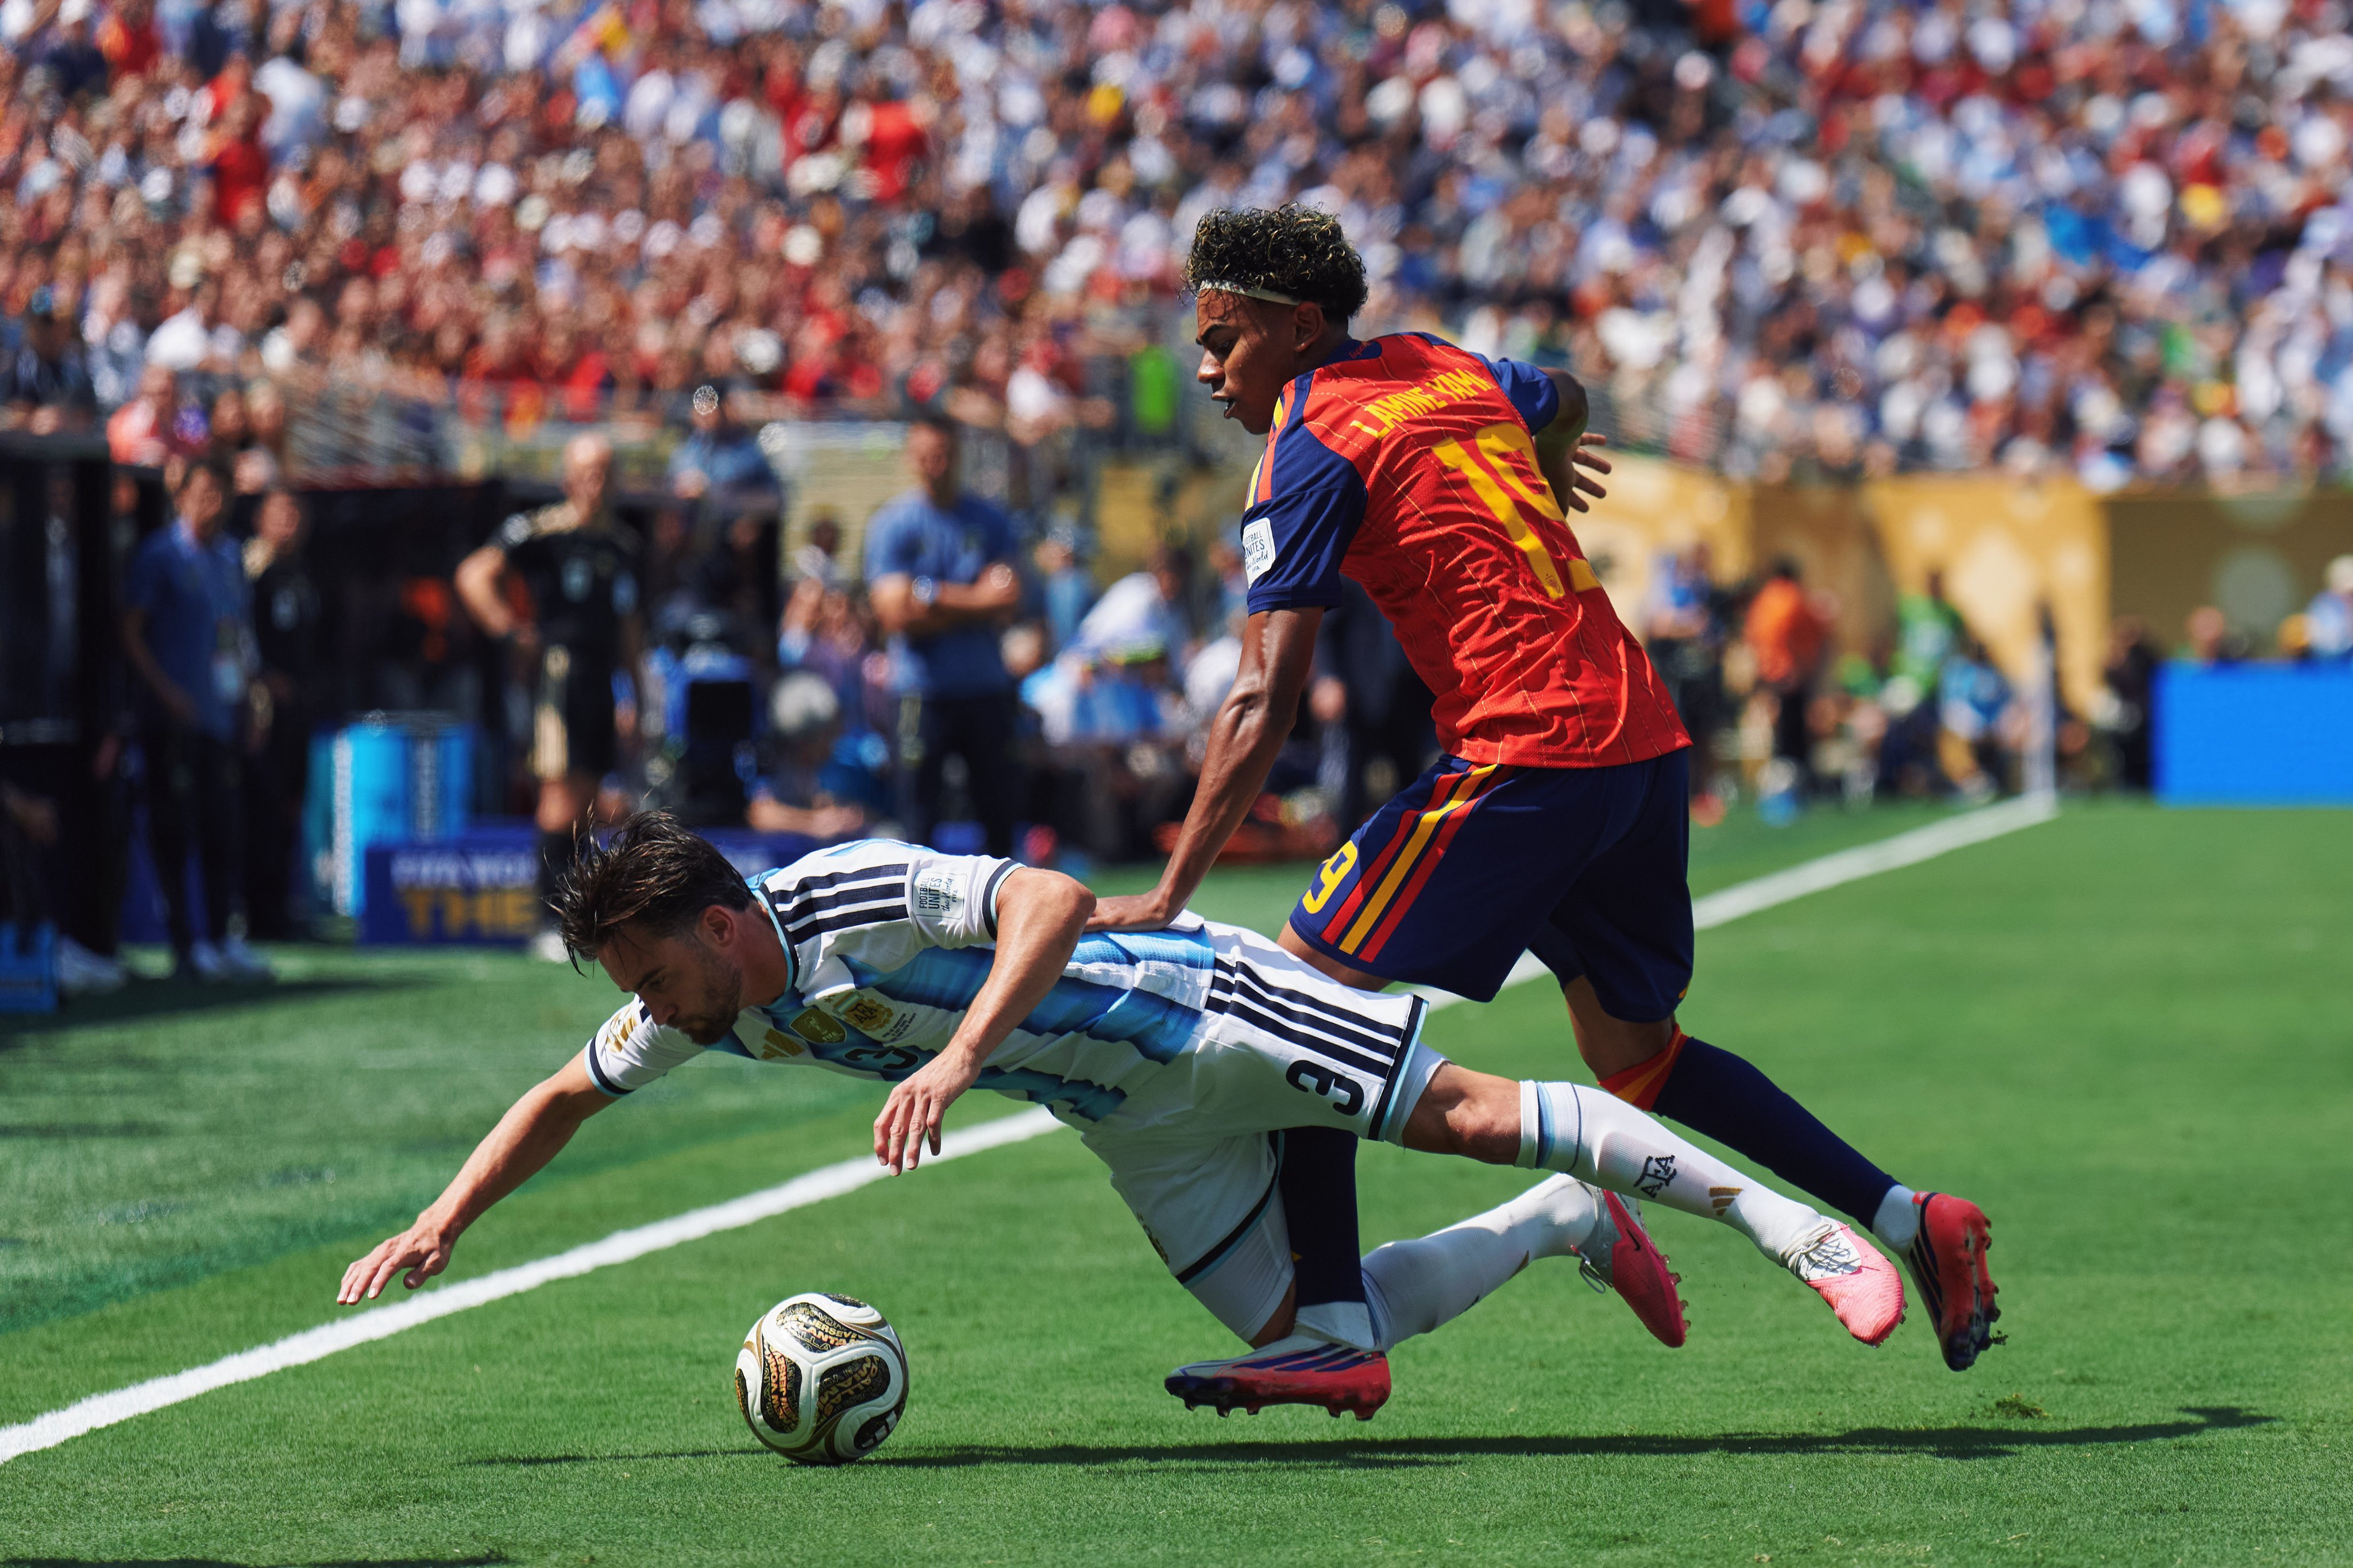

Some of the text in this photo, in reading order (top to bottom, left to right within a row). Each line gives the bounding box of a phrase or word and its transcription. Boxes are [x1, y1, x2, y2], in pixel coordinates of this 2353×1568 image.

[1350, 368, 1492, 440] LAMINE YAM
[1430, 422, 1602, 601] 19
[1252, 550, 1268, 566] World
[919, 877, 929, 909] FOOTBALL
[928, 878, 942, 909] UNITES
[940, 878, 954, 912] the World
[843, 1048, 919, 1069] 3
[1286, 1060, 1364, 1116] 3
